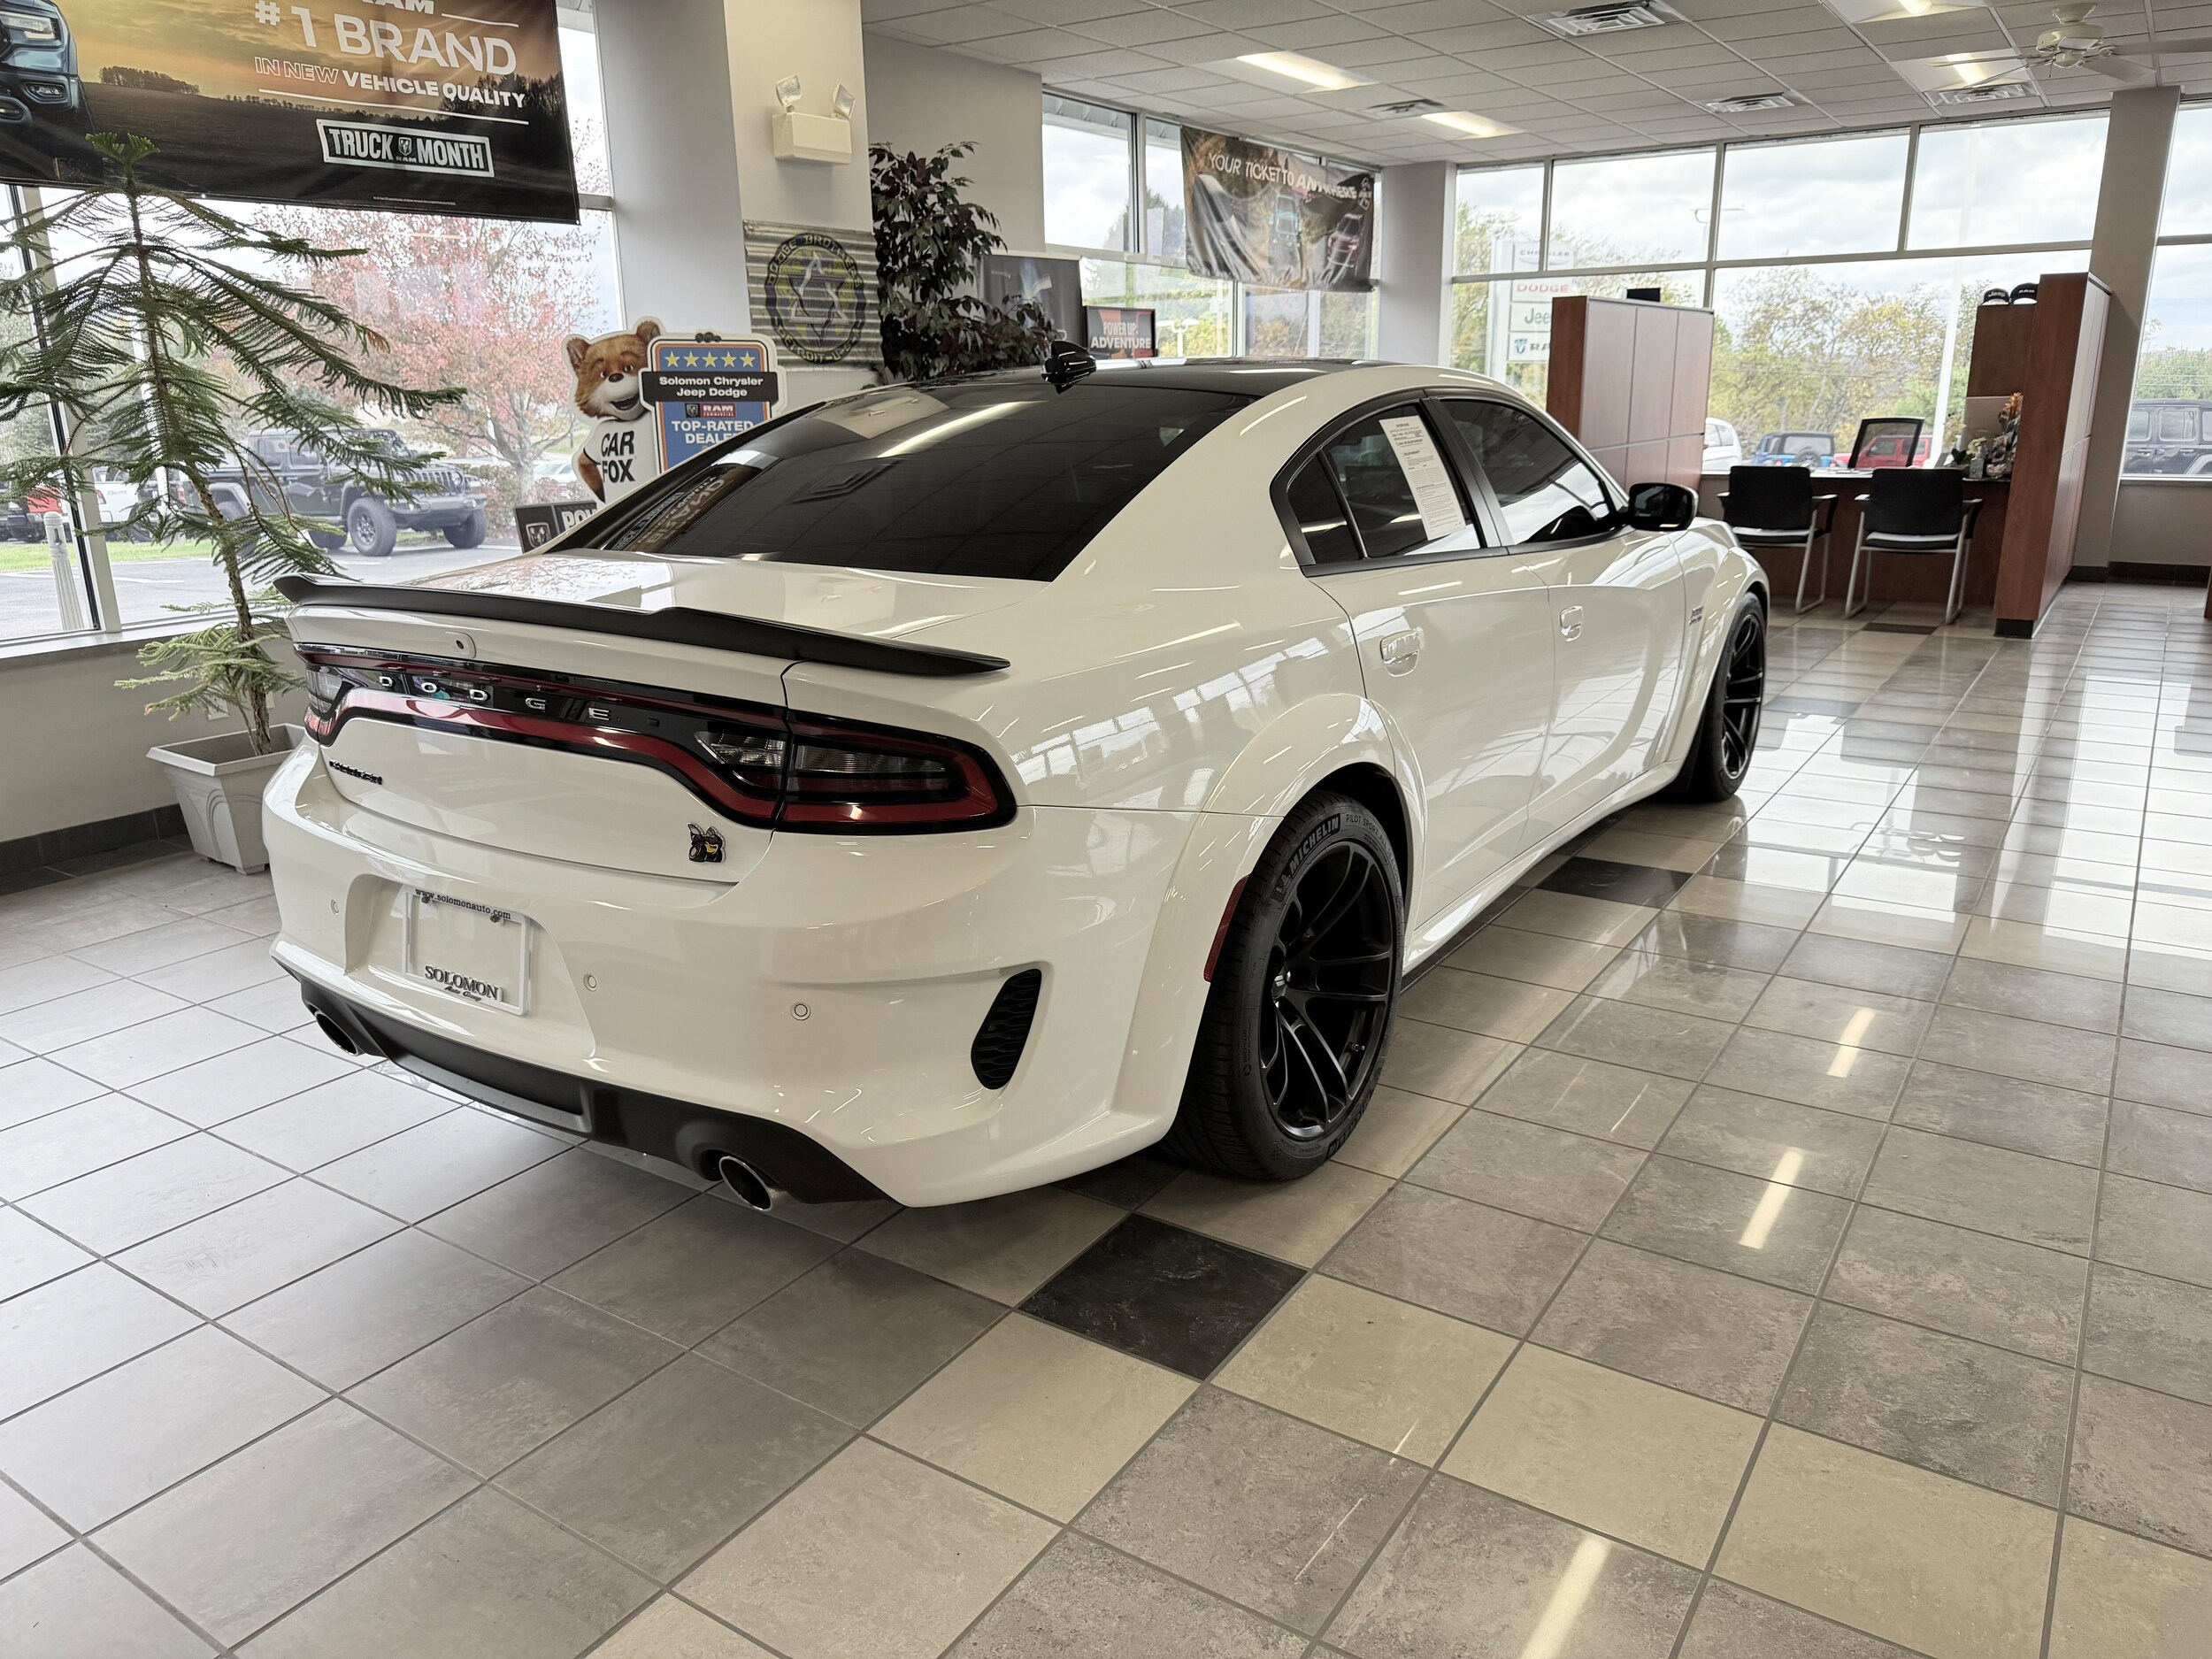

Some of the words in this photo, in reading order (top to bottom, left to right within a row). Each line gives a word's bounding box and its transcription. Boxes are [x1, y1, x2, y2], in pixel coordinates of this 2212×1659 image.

[363, 0, 435, 15] AM
[334, 13, 517, 75] BRAND
[255, 56, 280, 76] IN
[283, 61, 339, 85] NEW
[342, 70, 440, 96] VEHICLE
[442, 82, 526, 108] QUALITY
[328, 128, 394, 160] TRUCK
[416, 138, 485, 169] MONTH
[1208, 152, 1241, 175] YOUR
[1245, 161, 1281, 183] TICKET
[1281, 169, 1294, 186] TO
[768, 242, 796, 286] DODGE
[803, 234, 864, 288] BROTHERS
[1517, 284, 1569, 293] DODGE
[1103, 321, 1127, 335] POWER
[1525, 308, 1550, 324] Jee
[1091, 336, 1152, 349] ADVENTURE
[659, 376, 710, 386] Solomon
[713, 376, 764, 387] Chrysler
[676, 388, 706, 398] Jeep
[709, 388, 748, 398] Dodge
[672, 420, 754, 432] TOP-RATED
[685, 433, 741, 444] DEALE
[601, 430, 634, 457] CAR
[602, 458, 635, 484] FOX
[379, 675, 611, 721] DODGE
[1289, 817, 1340, 875] MICHELIN
[1346, 813, 1362, 824] PILOT
[1363, 818, 1379, 836] SPORT
[415, 888, 511, 920] www.solomonauto.com
[425, 965, 499, 1001] SOLOMON
[444, 986, 461, 995] Auto
[462, 991, 482, 1002] Group
